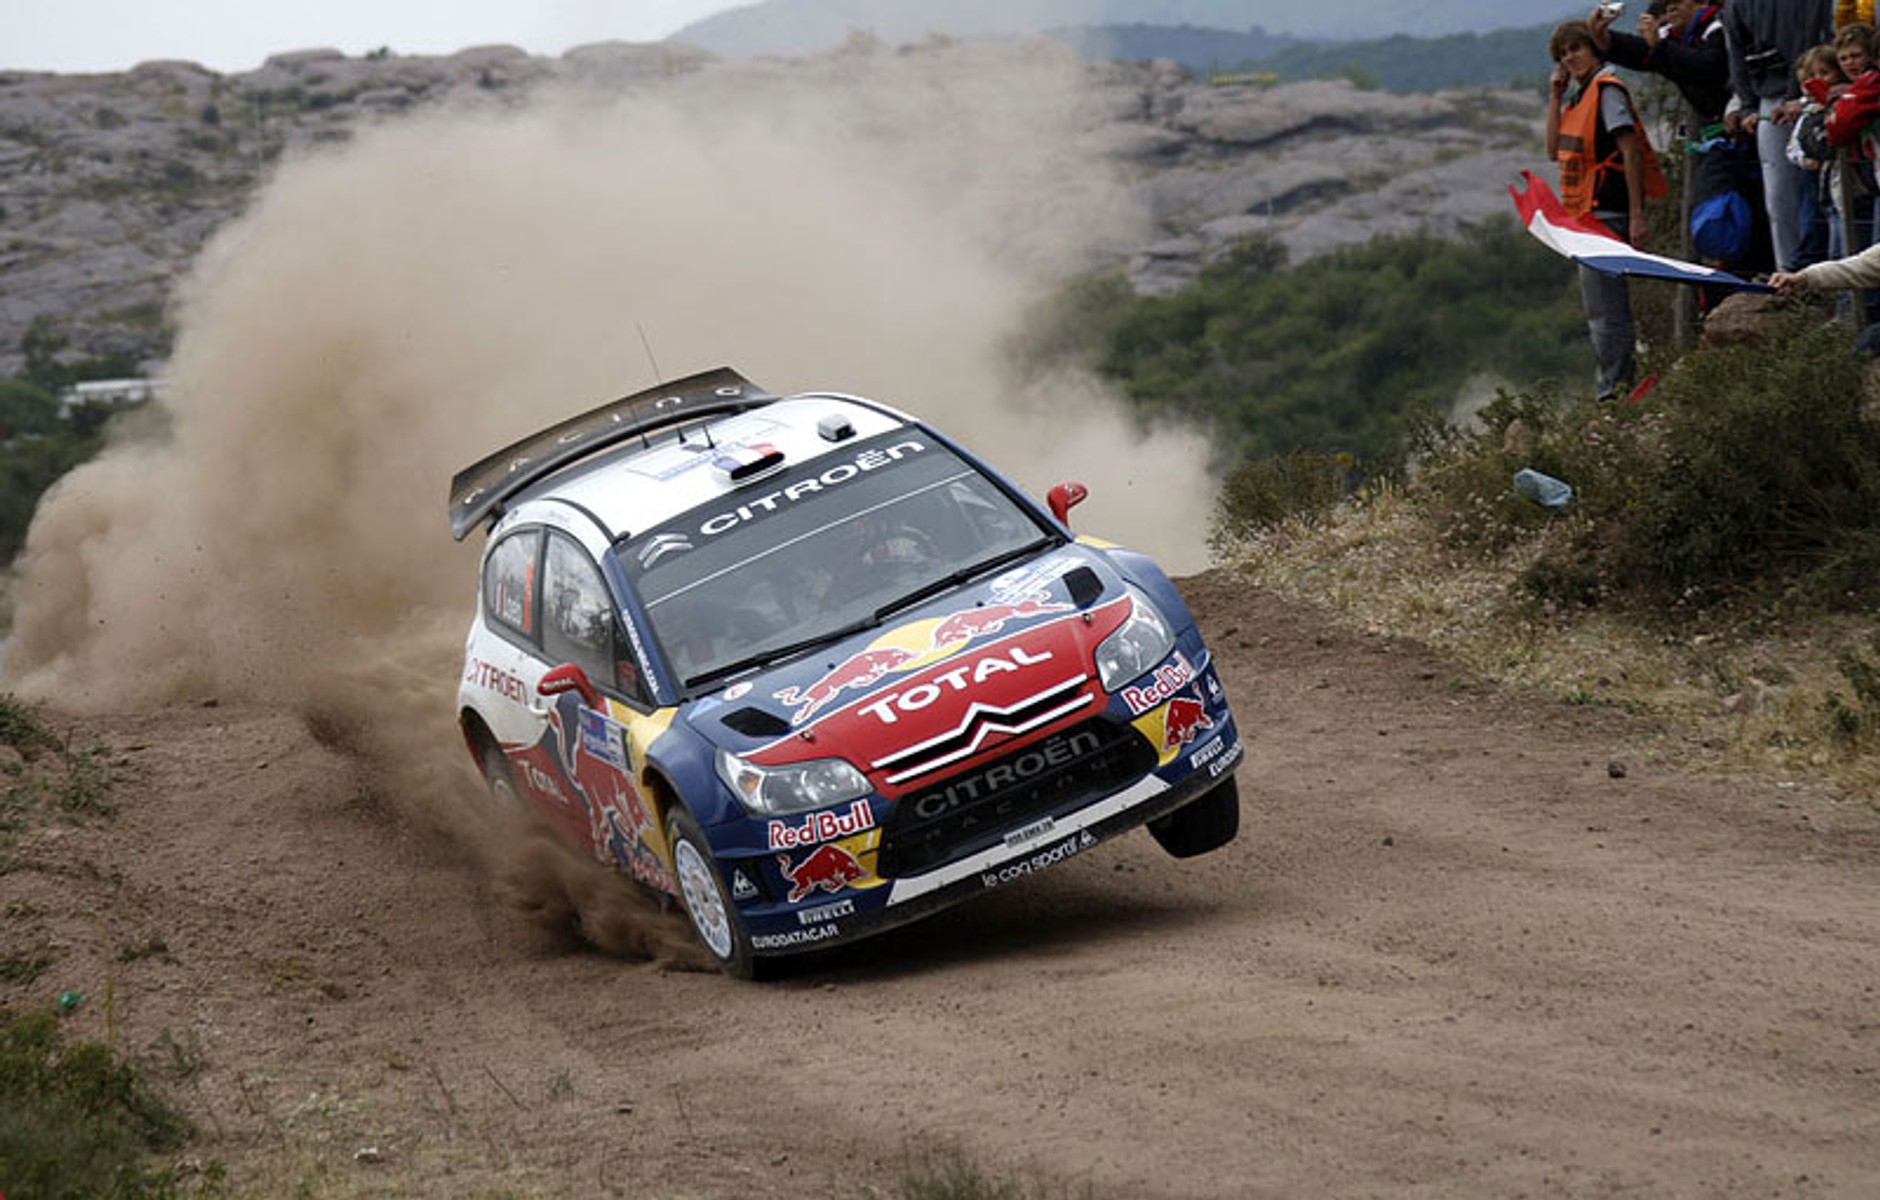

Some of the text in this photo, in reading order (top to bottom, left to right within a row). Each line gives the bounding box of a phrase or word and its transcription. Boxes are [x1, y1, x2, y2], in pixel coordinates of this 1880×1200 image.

[857, 646, 1053, 724] TOTAL
[1121, 669, 1171, 716] Red
[768, 798, 875, 849] Red Bull
[981, 873, 998, 887] le
[998, 861, 1032, 882] coq
